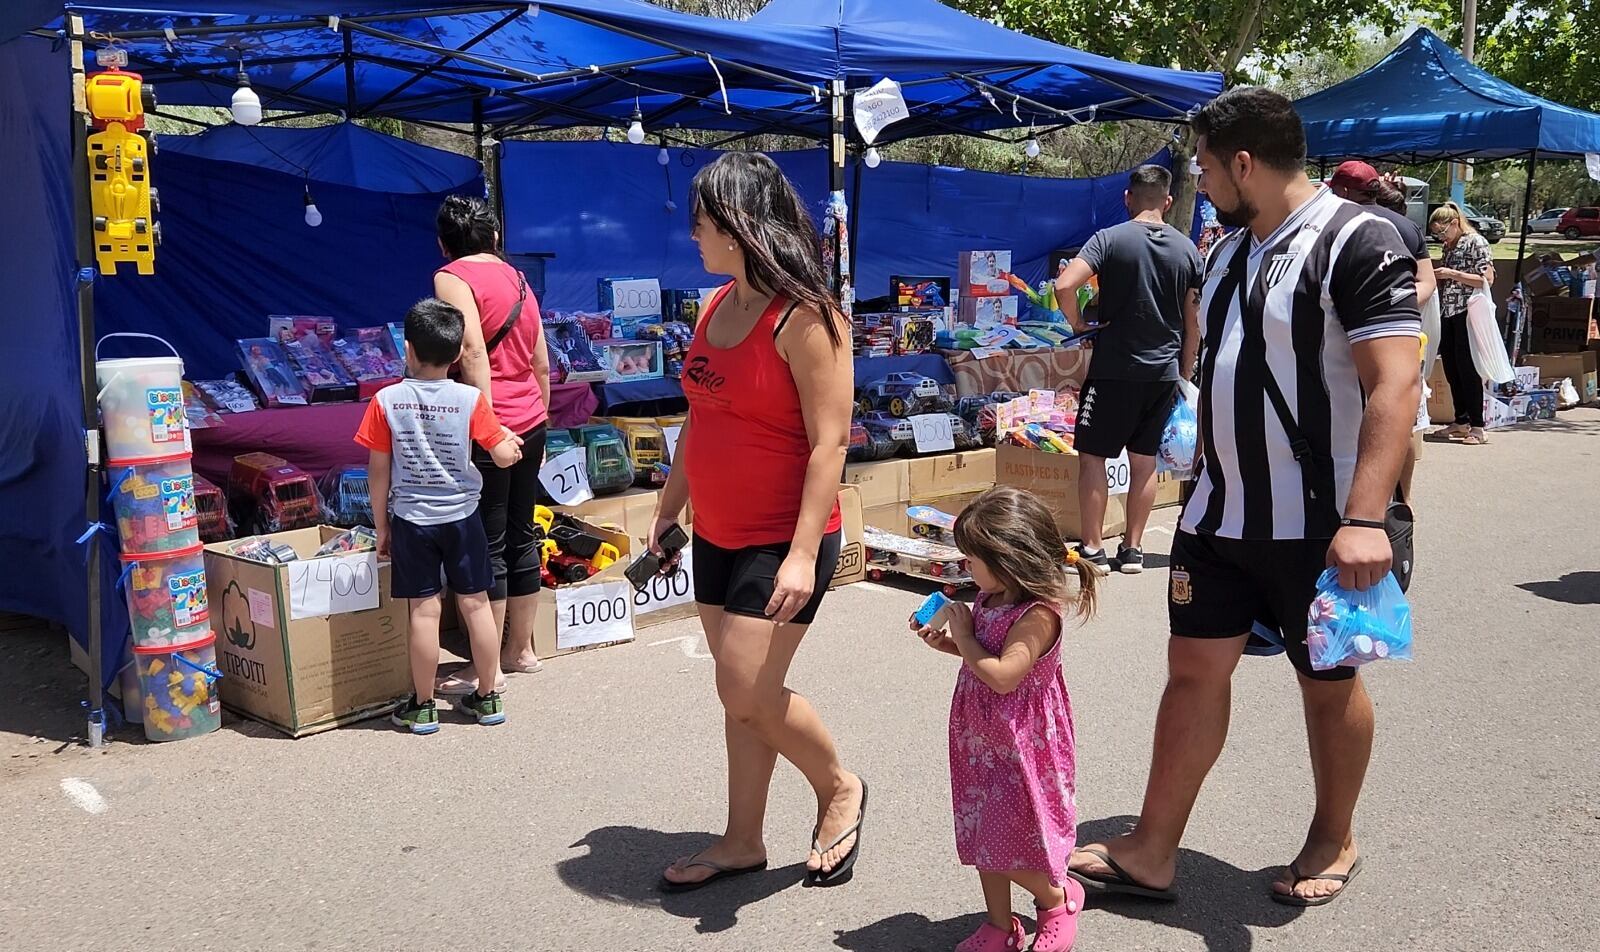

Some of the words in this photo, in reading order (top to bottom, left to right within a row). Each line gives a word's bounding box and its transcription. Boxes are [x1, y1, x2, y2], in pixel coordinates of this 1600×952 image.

[617, 289, 658, 308] 2000
[393, 403, 460, 414] EGRESADITOS
[415, 413, 436, 421] 2022
[834, 552, 859, 575] gar
[296, 561, 373, 606] 1400
[567, 597, 627, 627] 1000
[377, 615, 394, 634] 3
[224, 651, 267, 686] TIPOITI
